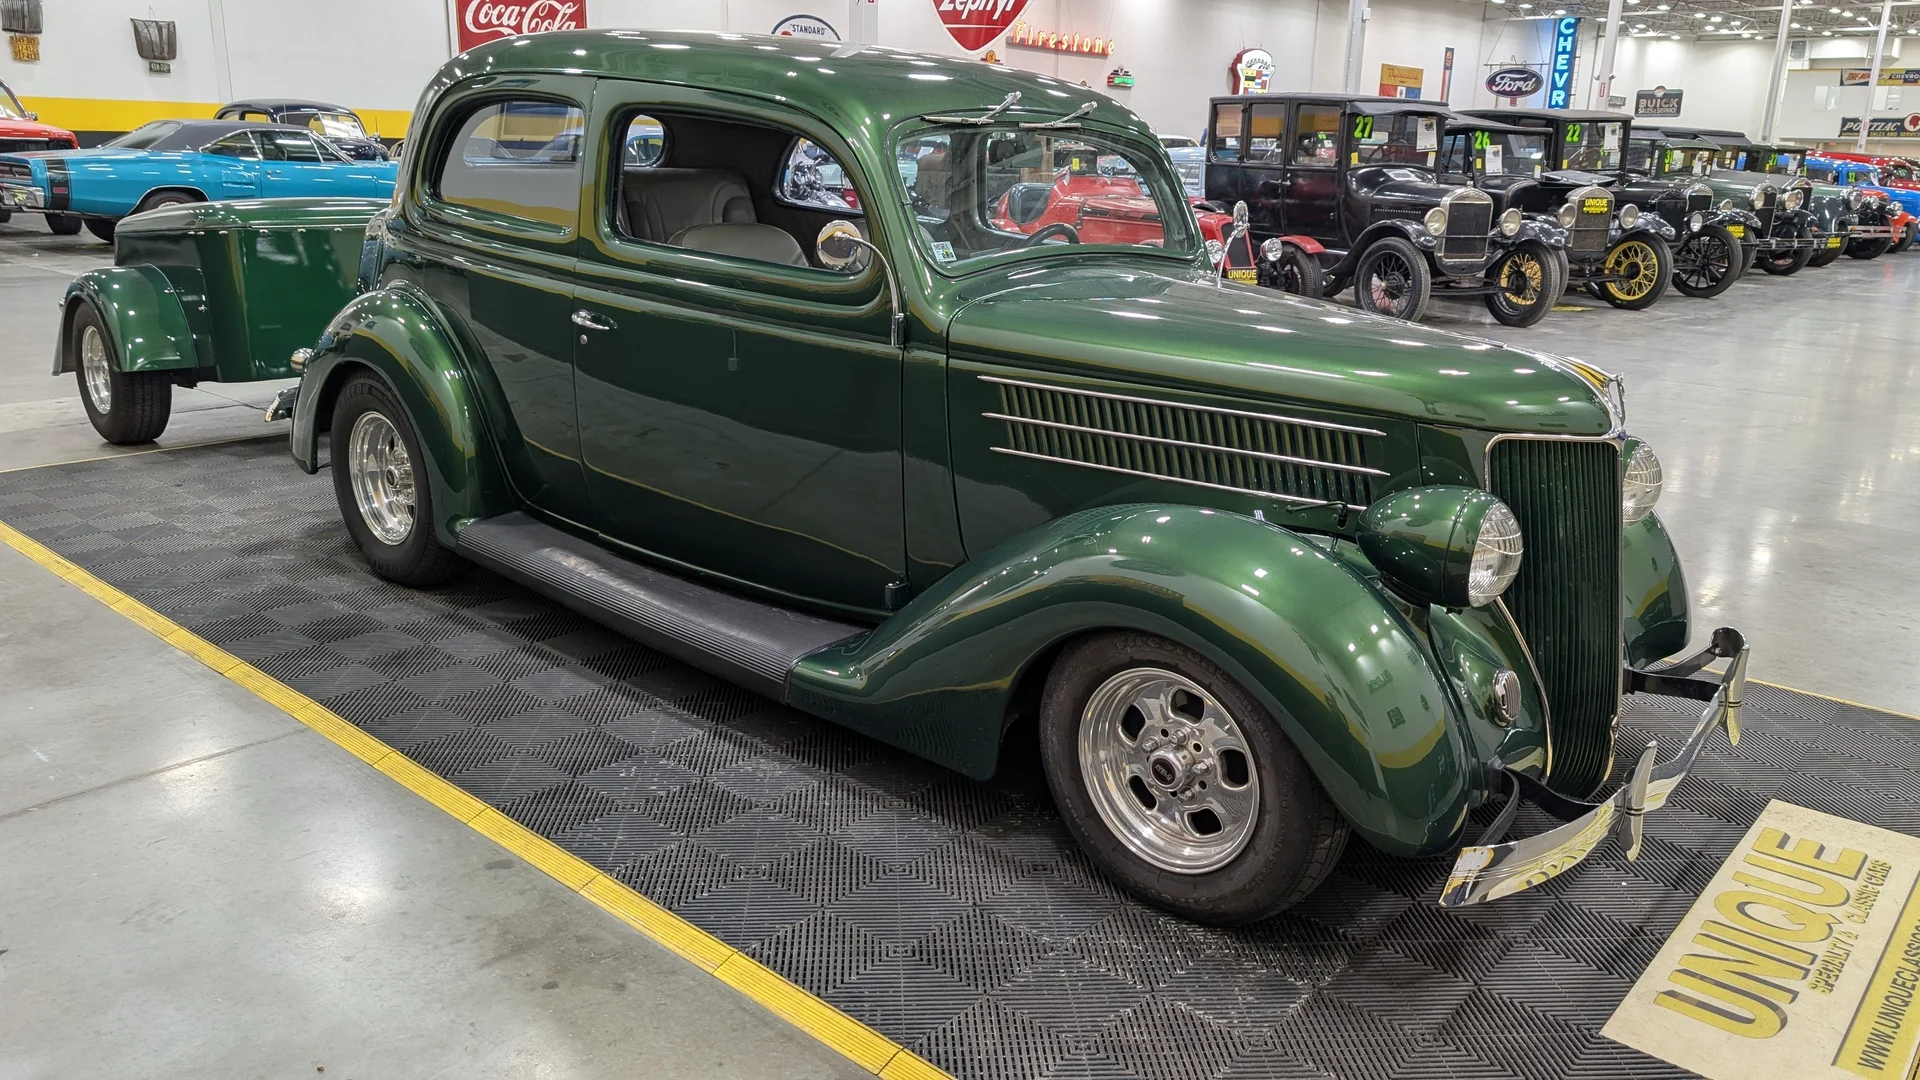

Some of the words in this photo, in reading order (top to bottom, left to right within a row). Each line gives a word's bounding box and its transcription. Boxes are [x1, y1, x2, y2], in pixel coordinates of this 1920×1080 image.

[1013, 20, 1116, 56] Firestone
[1550, 17, 1576, 110] CHEVR
[1492, 73, 1536, 92] Ford
[1638, 98, 1679, 108] BUICK
[1354, 115, 1373, 138] 27
[1565, 124, 1581, 142] 22
[1842, 121, 1901, 131] POTIAC
[1474, 130, 1490, 150] 26
[1585, 198, 1608, 206] UNIQUE
[1228, 269, 1257, 279] UNIQUE
[1653, 827, 1869, 1040] UNIQUE
[1807, 936, 1854, 995] SPECIALTY
[1843, 883, 1881, 924] CLASSIC
[1864, 859, 1893, 887] CARS
